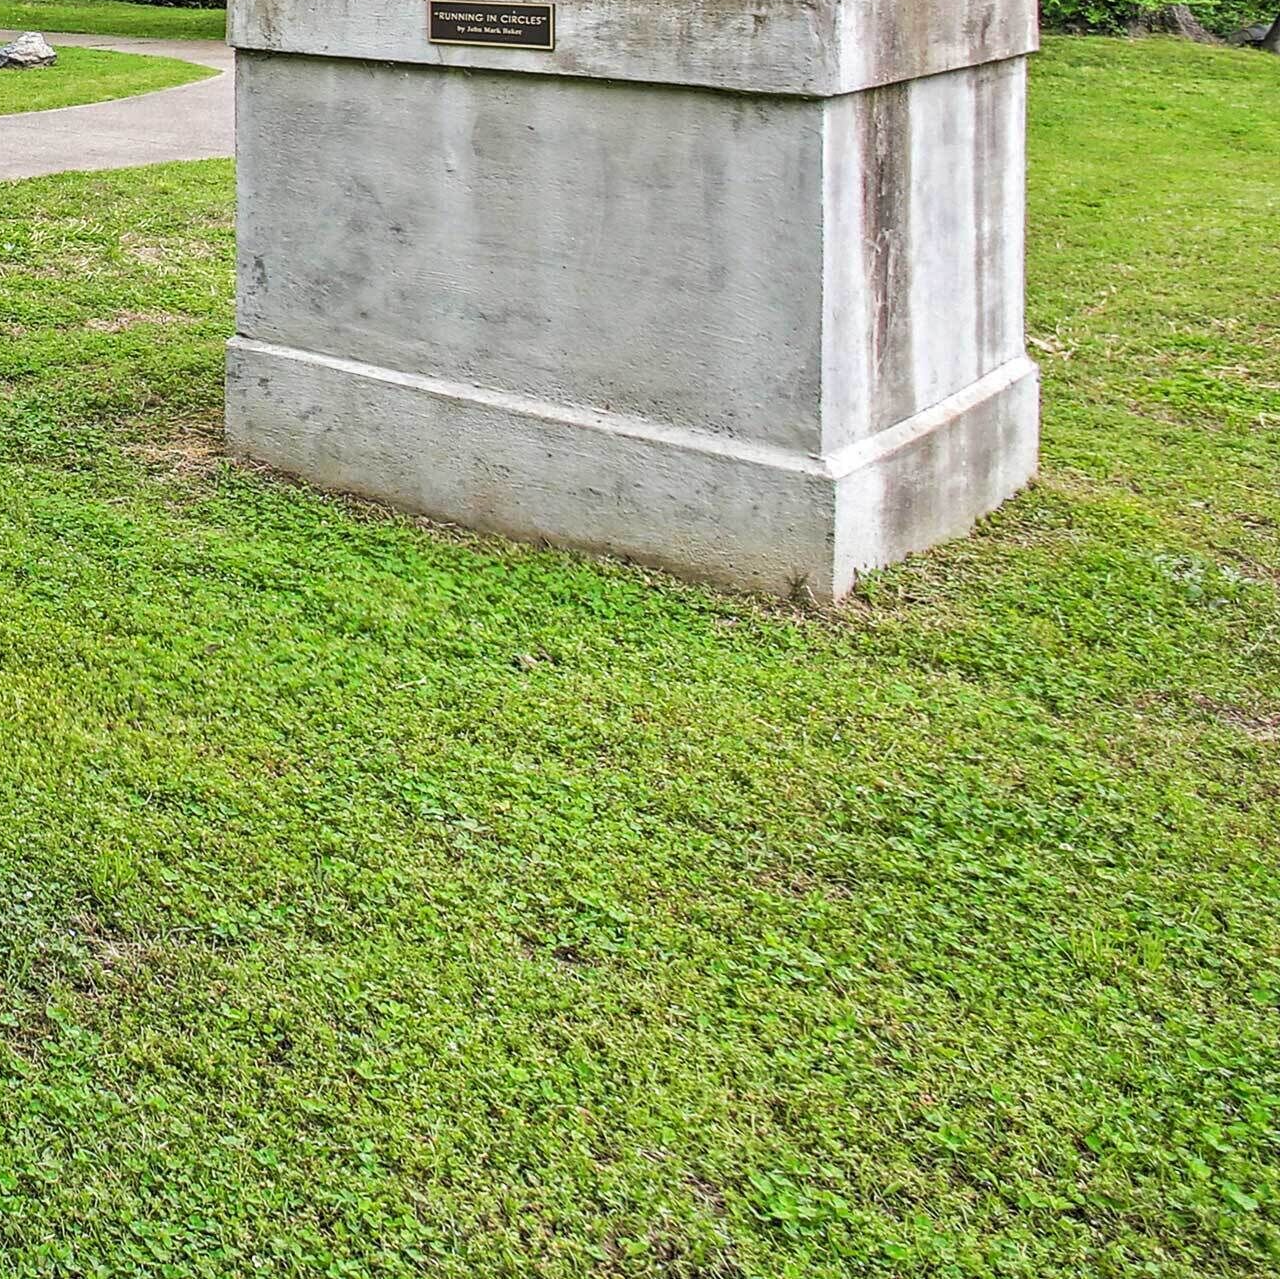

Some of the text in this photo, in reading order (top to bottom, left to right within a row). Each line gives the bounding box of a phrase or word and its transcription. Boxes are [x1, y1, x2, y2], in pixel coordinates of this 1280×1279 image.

[433, 11, 547, 25] "RUNNING IN CIRCLES"
[457, 25, 465, 34] by
[484, 26, 501, 34] Mark
[503, 27, 523, 35] Baker
